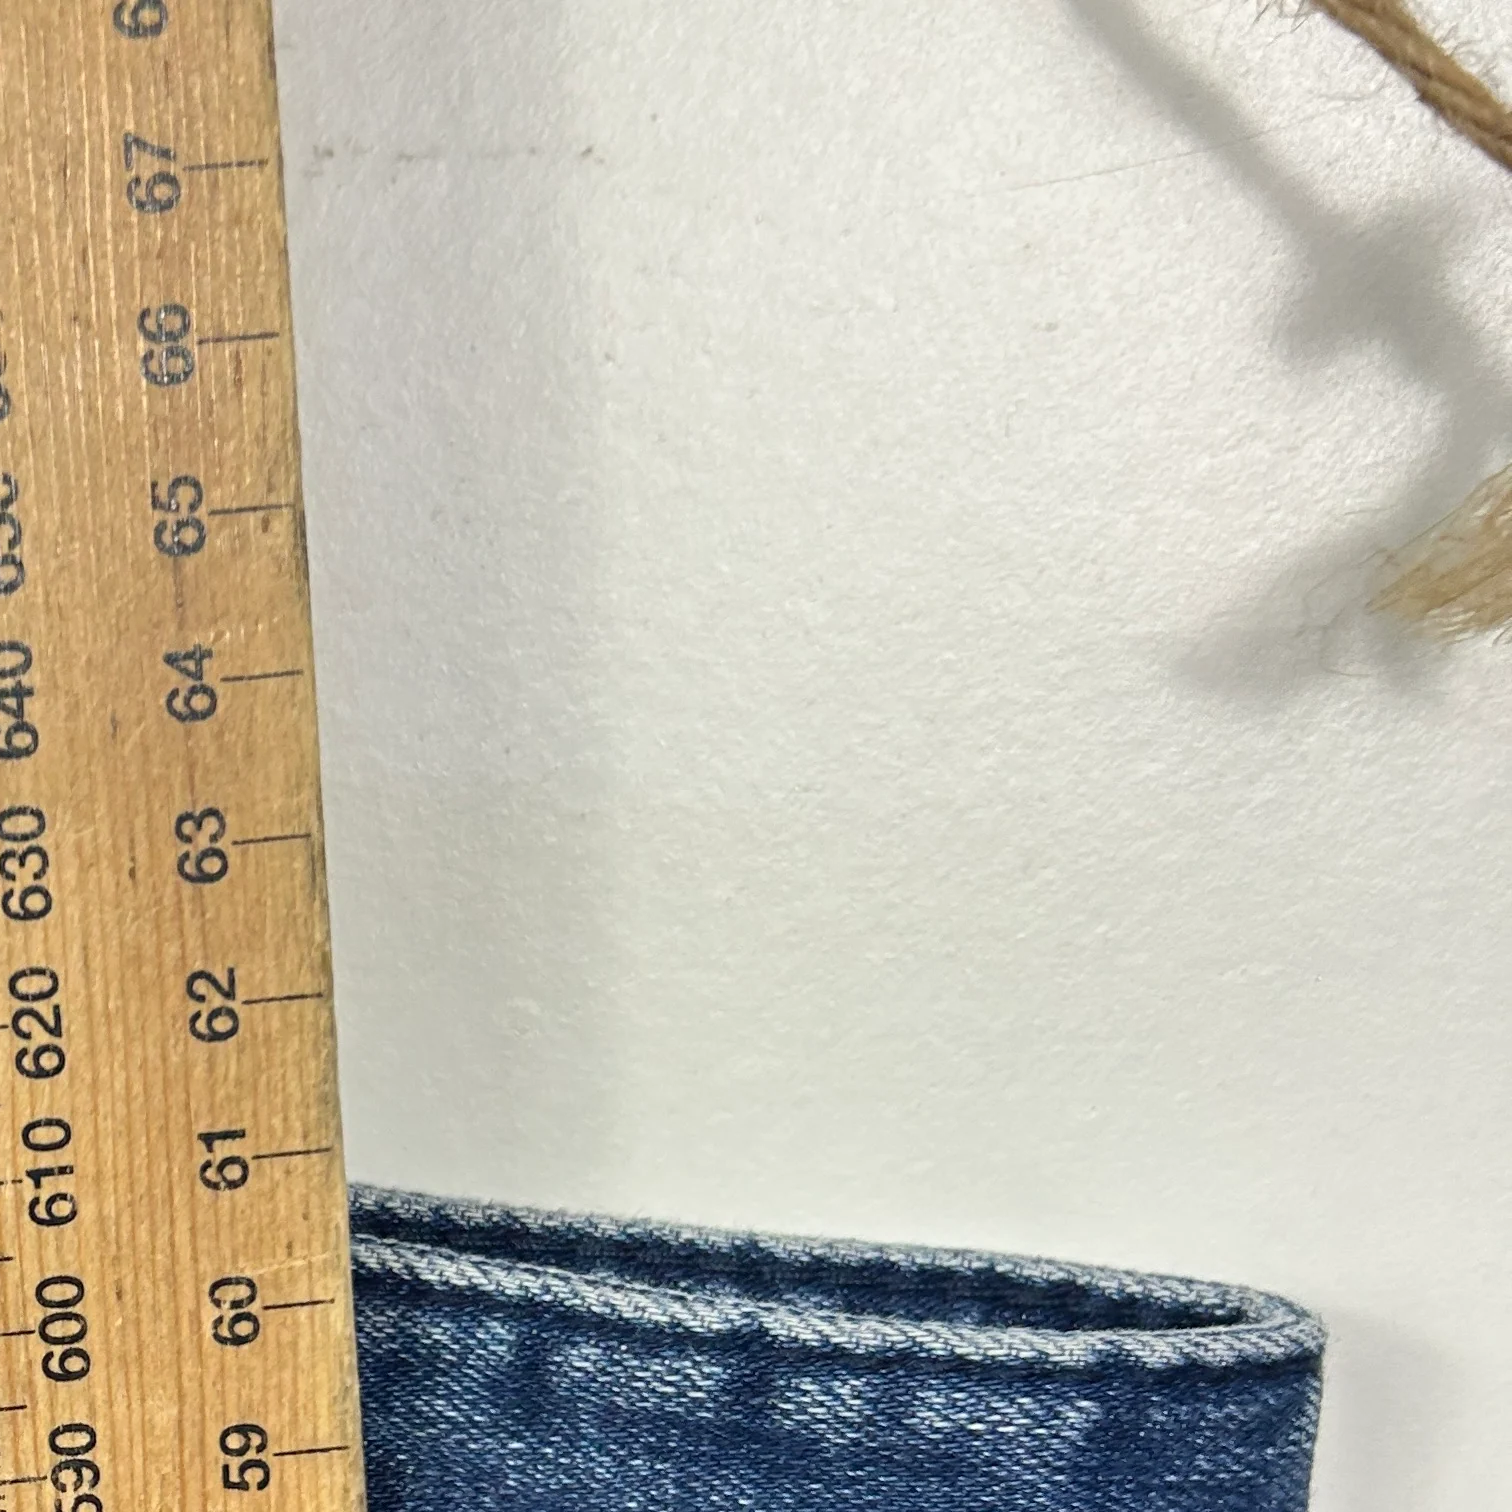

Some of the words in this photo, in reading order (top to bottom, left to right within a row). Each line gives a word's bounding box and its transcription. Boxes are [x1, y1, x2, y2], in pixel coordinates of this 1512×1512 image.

[124, 133, 180, 214] 67
[138, 304, 194, 387] 66
[151, 476, 206, 557] 65
[164, 644, 217, 723] 64
[175, 808, 228, 884] 63
[9, 968, 65, 1079] 620
[186, 968, 239, 1043] 62
[22, 1118, 77, 1227] 610
[198, 1129, 249, 1190] 61
[35, 1276, 90, 1382] 600
[209, 1277, 260, 1347] 60
[220, 1424, 270, 1491] 59
